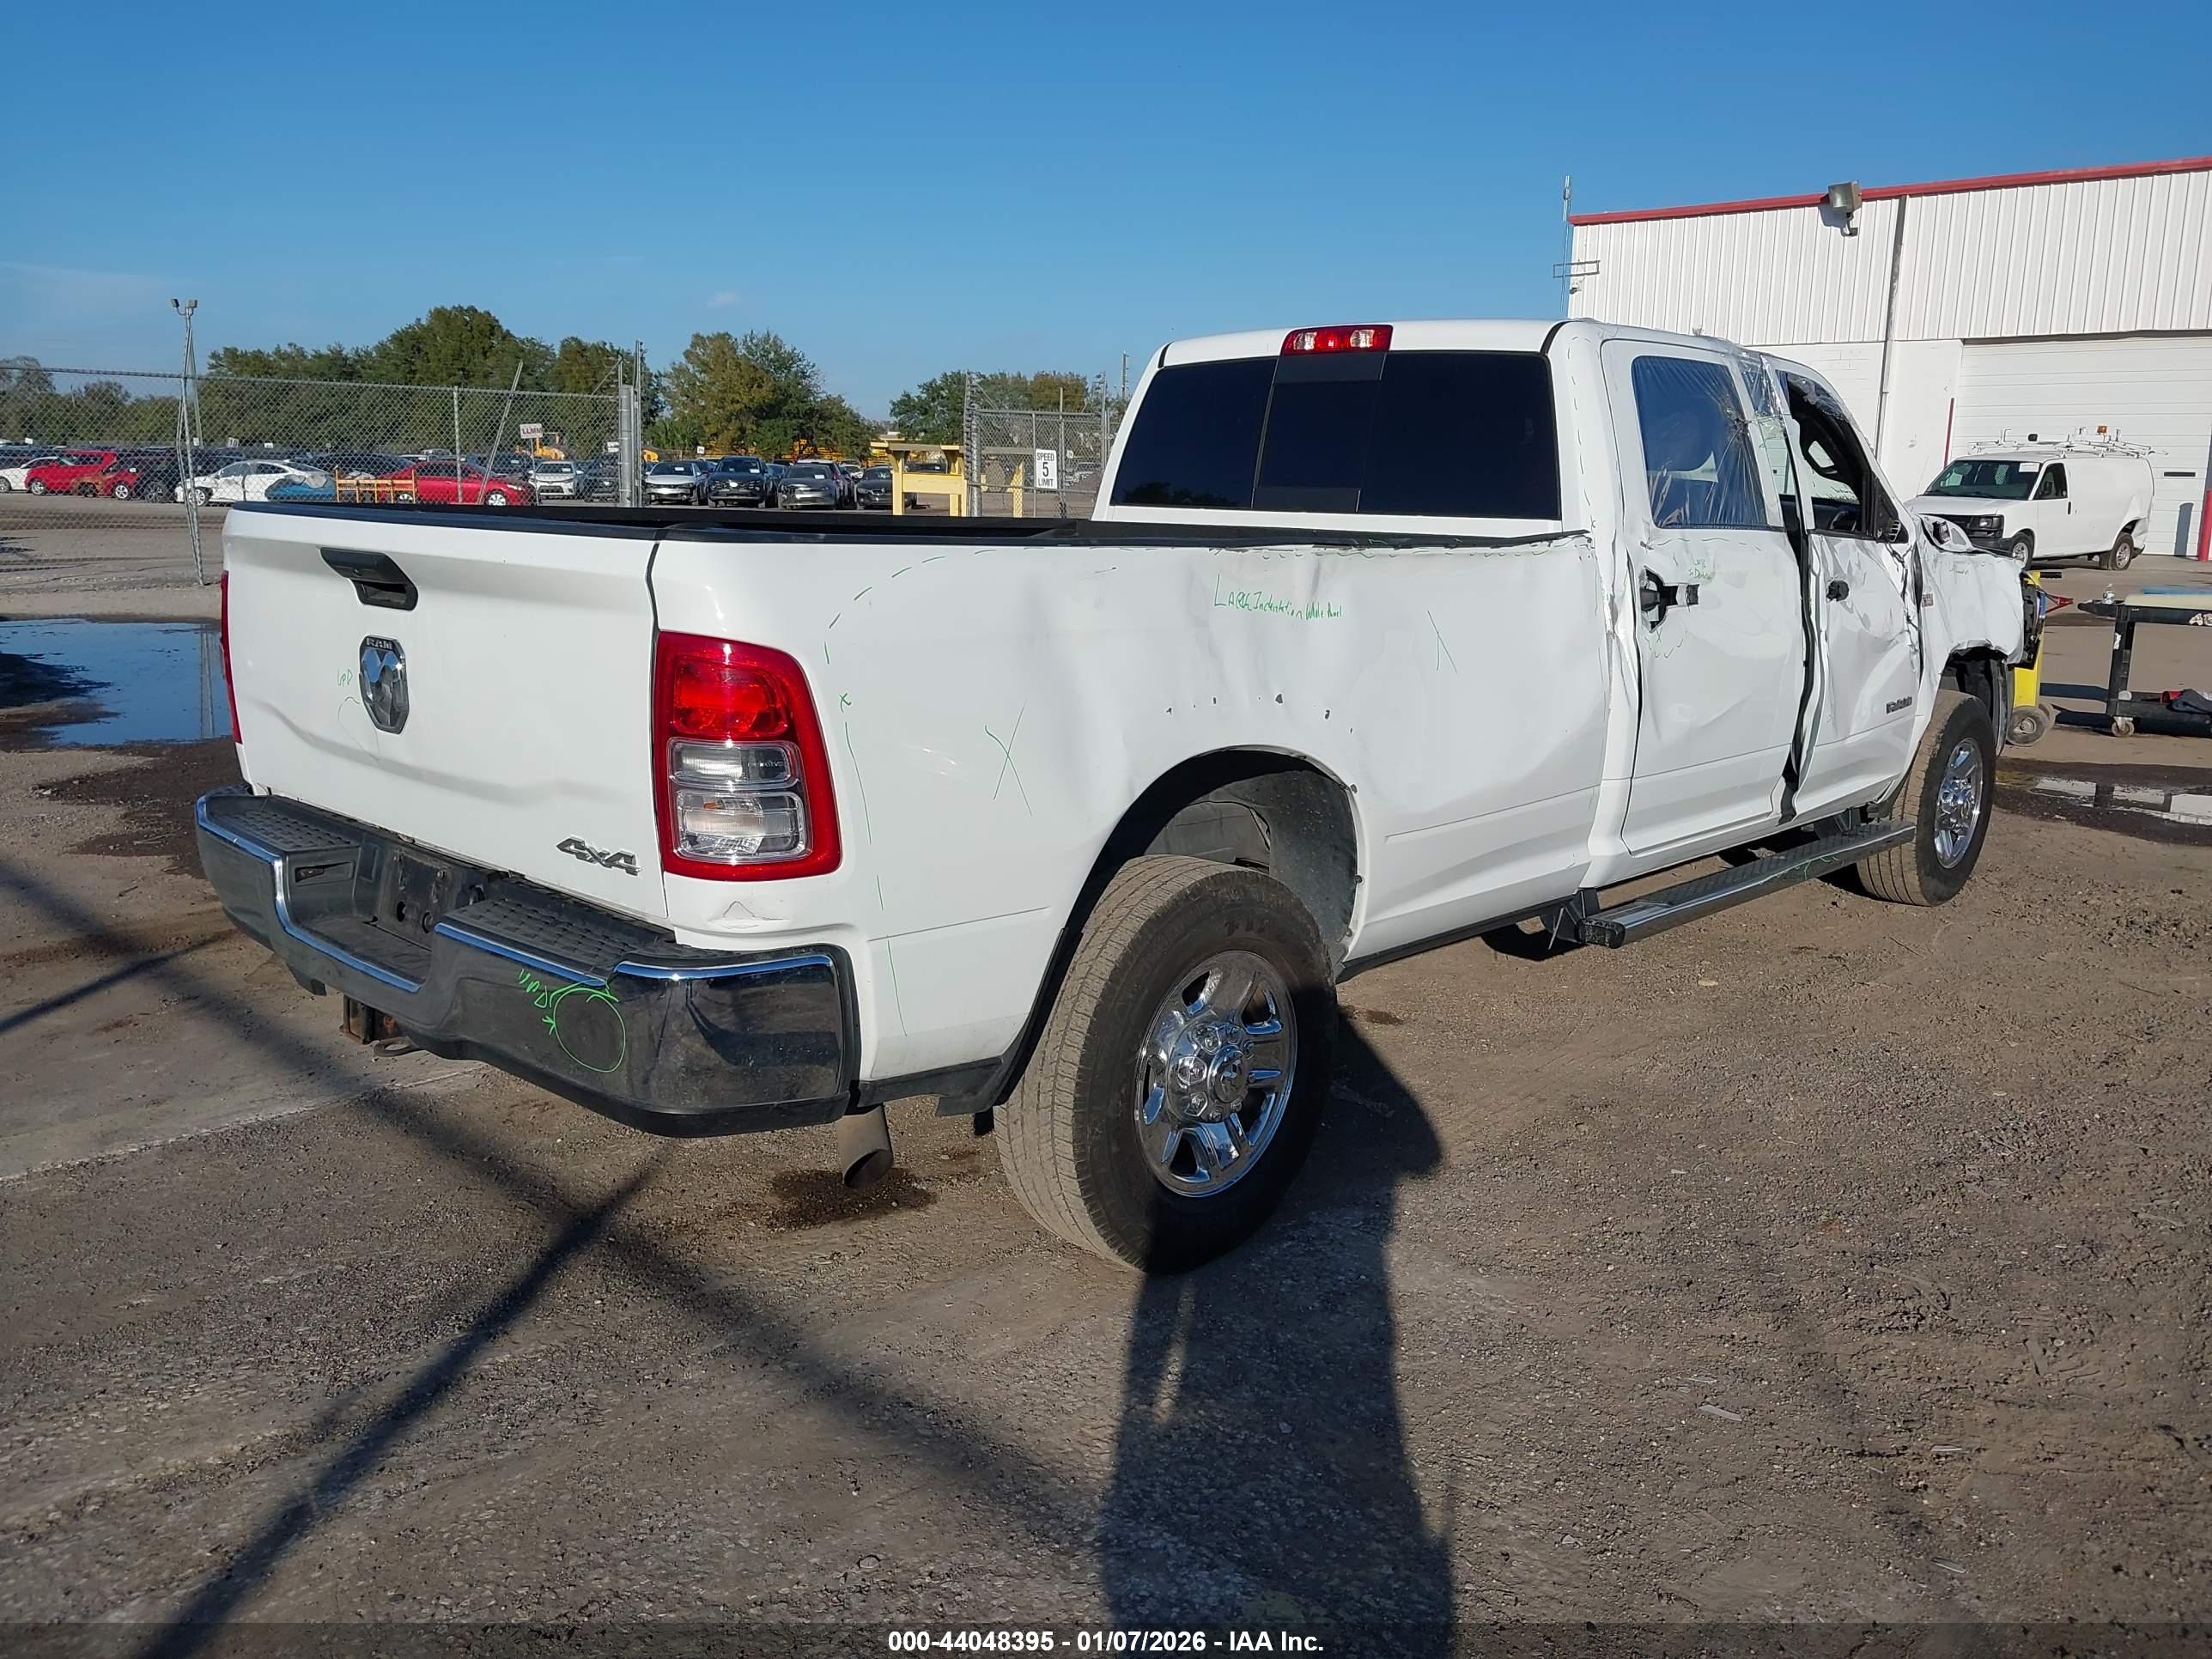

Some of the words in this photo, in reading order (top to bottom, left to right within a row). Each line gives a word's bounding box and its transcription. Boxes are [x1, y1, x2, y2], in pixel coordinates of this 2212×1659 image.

[1036, 453, 1054, 461] SPEED
[1042, 461, 1049, 477] 5
[1037, 478, 1054, 487] LIMIT
[366, 637, 392, 650] RAM
